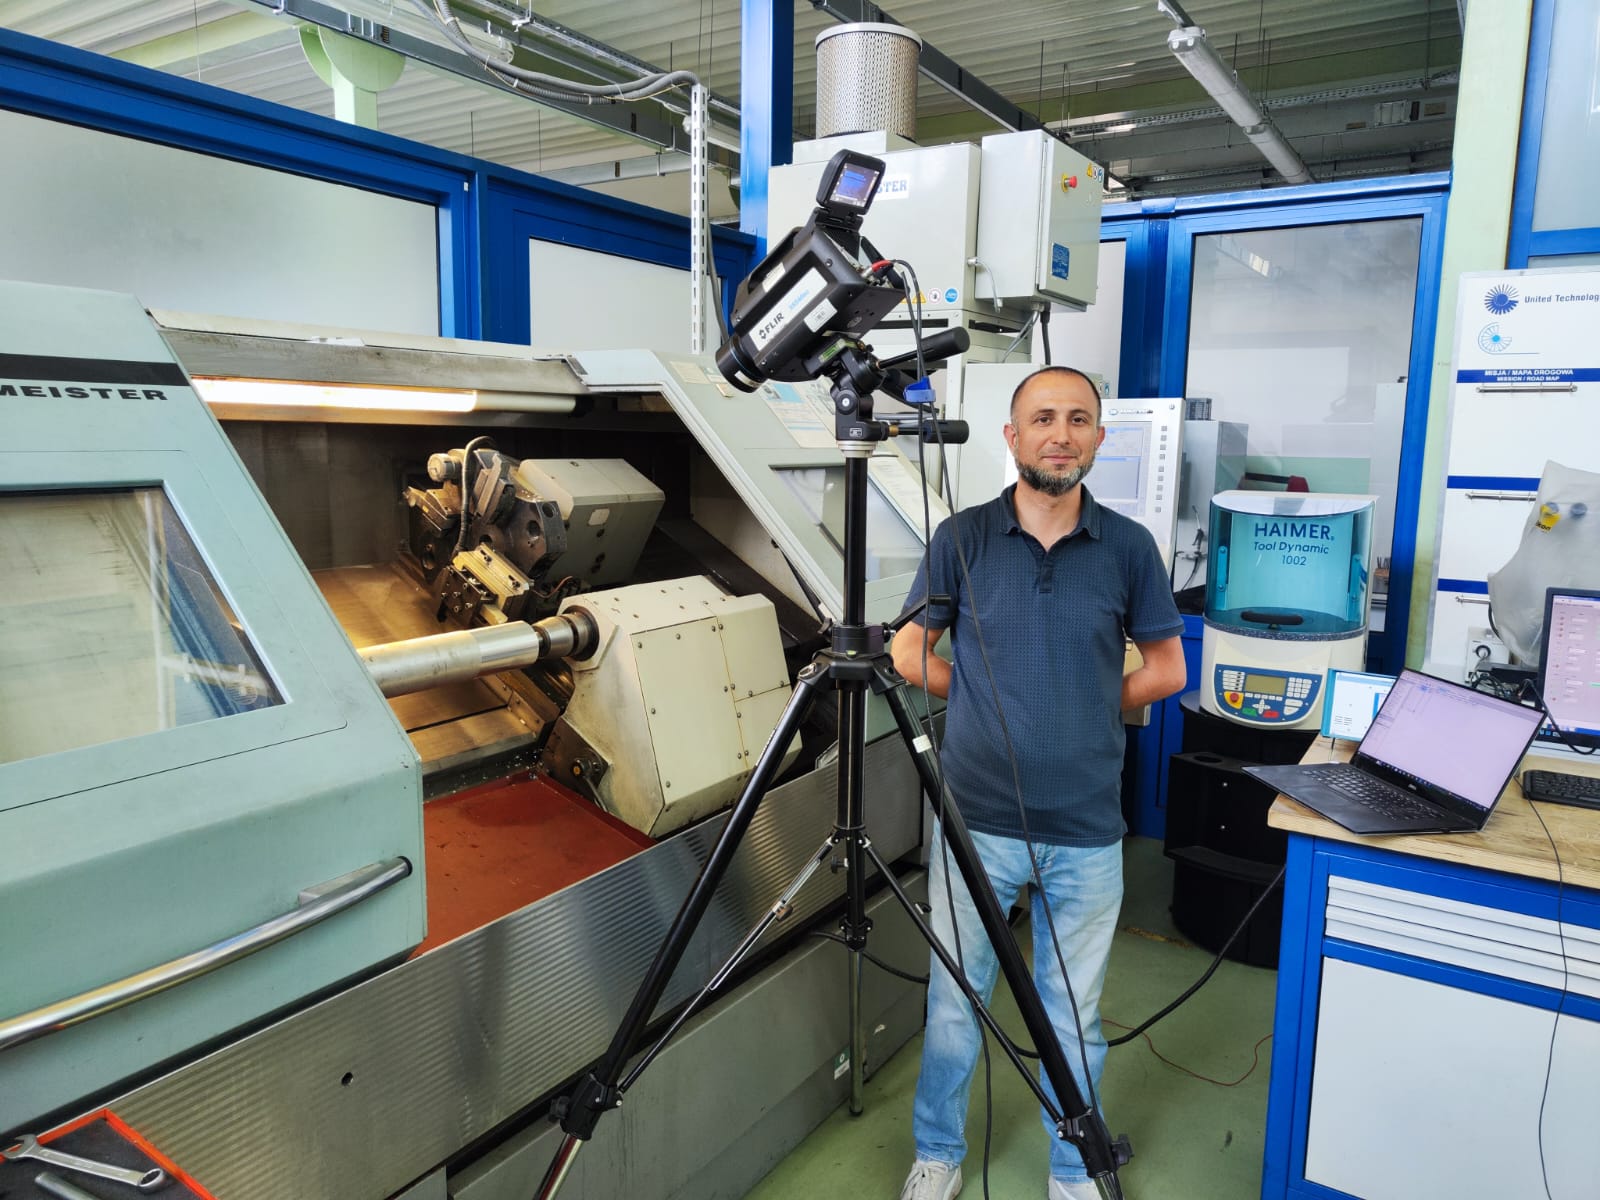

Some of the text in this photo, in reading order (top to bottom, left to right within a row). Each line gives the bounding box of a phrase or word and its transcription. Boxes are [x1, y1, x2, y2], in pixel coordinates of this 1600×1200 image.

[1524, 295, 1552, 304] United
[764, 312, 784, 333] FLIR
[1254, 541, 1330, 554] Tool Dynamic
[1282, 555, 1307, 566] 1002
